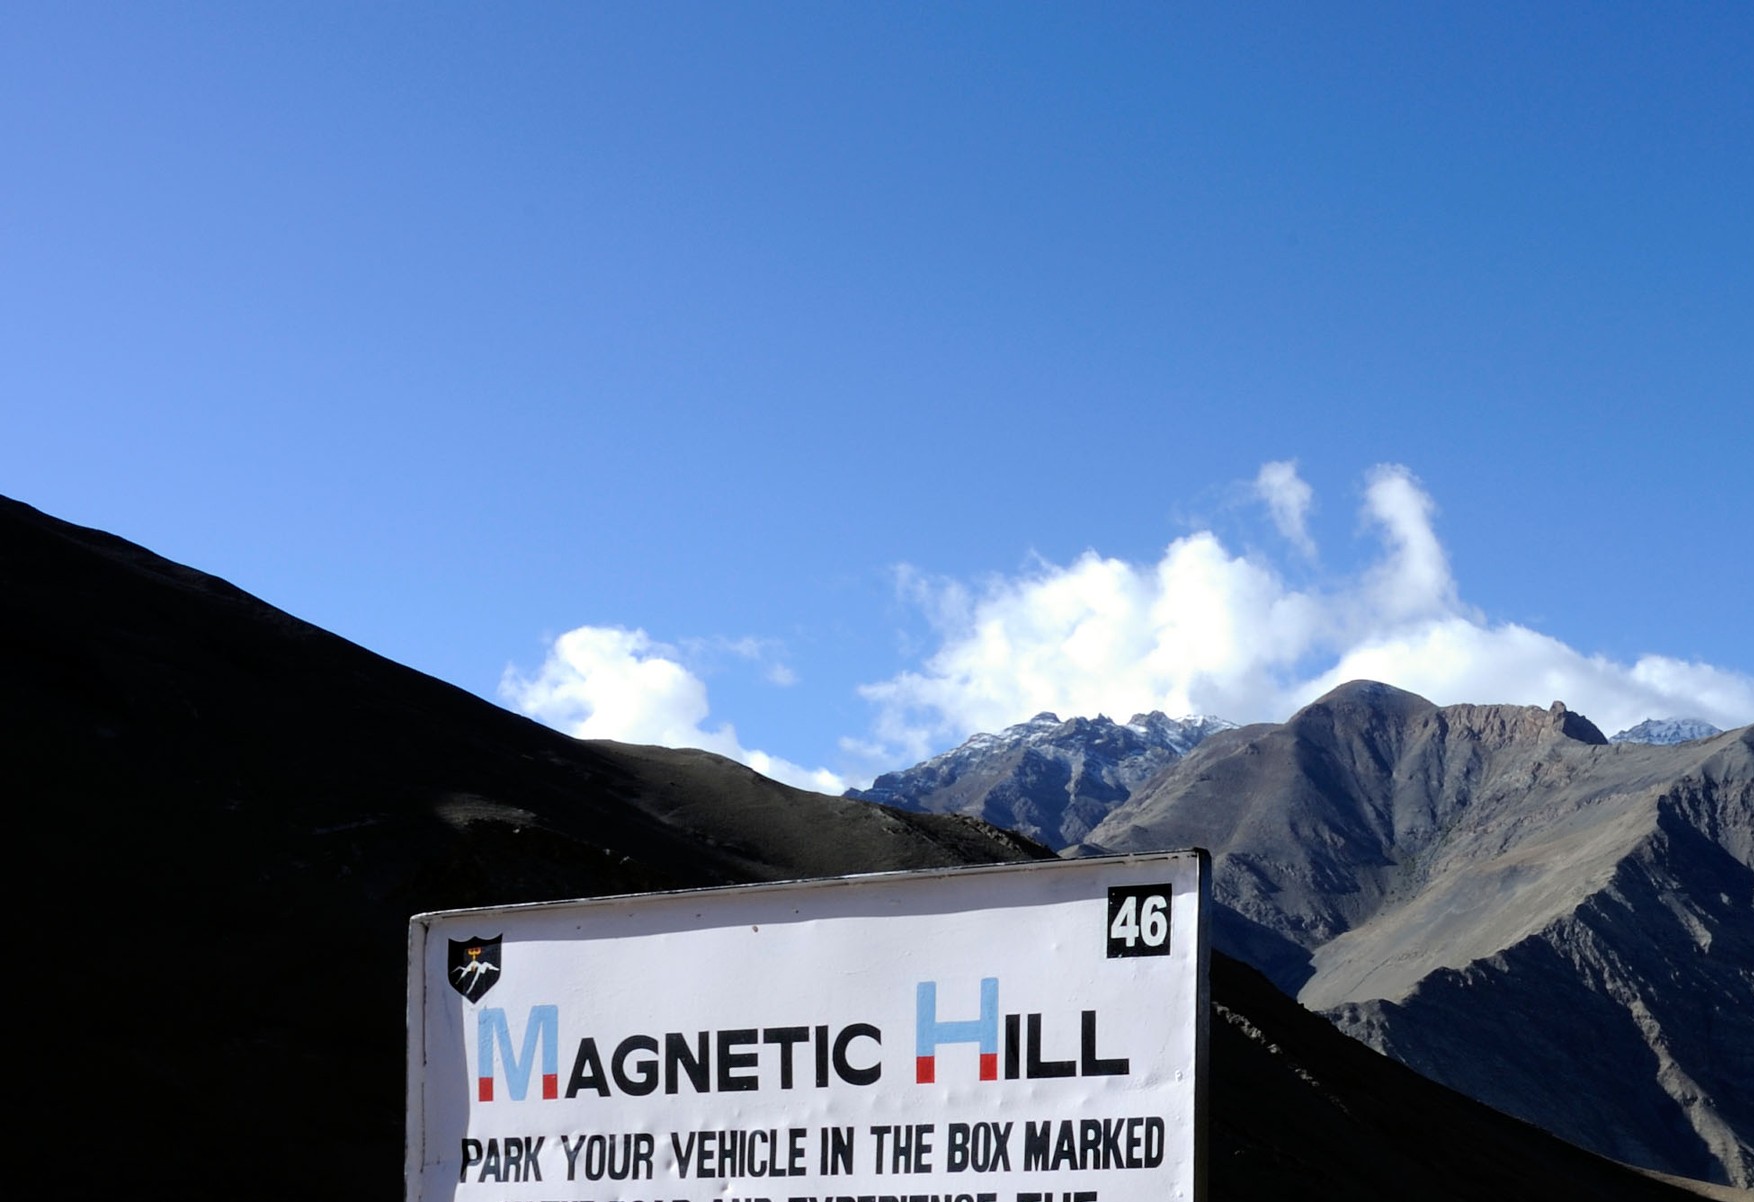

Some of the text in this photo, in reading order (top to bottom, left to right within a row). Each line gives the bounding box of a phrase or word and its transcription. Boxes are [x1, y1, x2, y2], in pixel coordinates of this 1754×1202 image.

[1110, 894, 1168, 948] 46
[478, 977, 1129, 1102] MAGNETIC HILL
[461, 1117, 1165, 1183] PARK YOUR VEHICLE IN THE BOX MARKED
